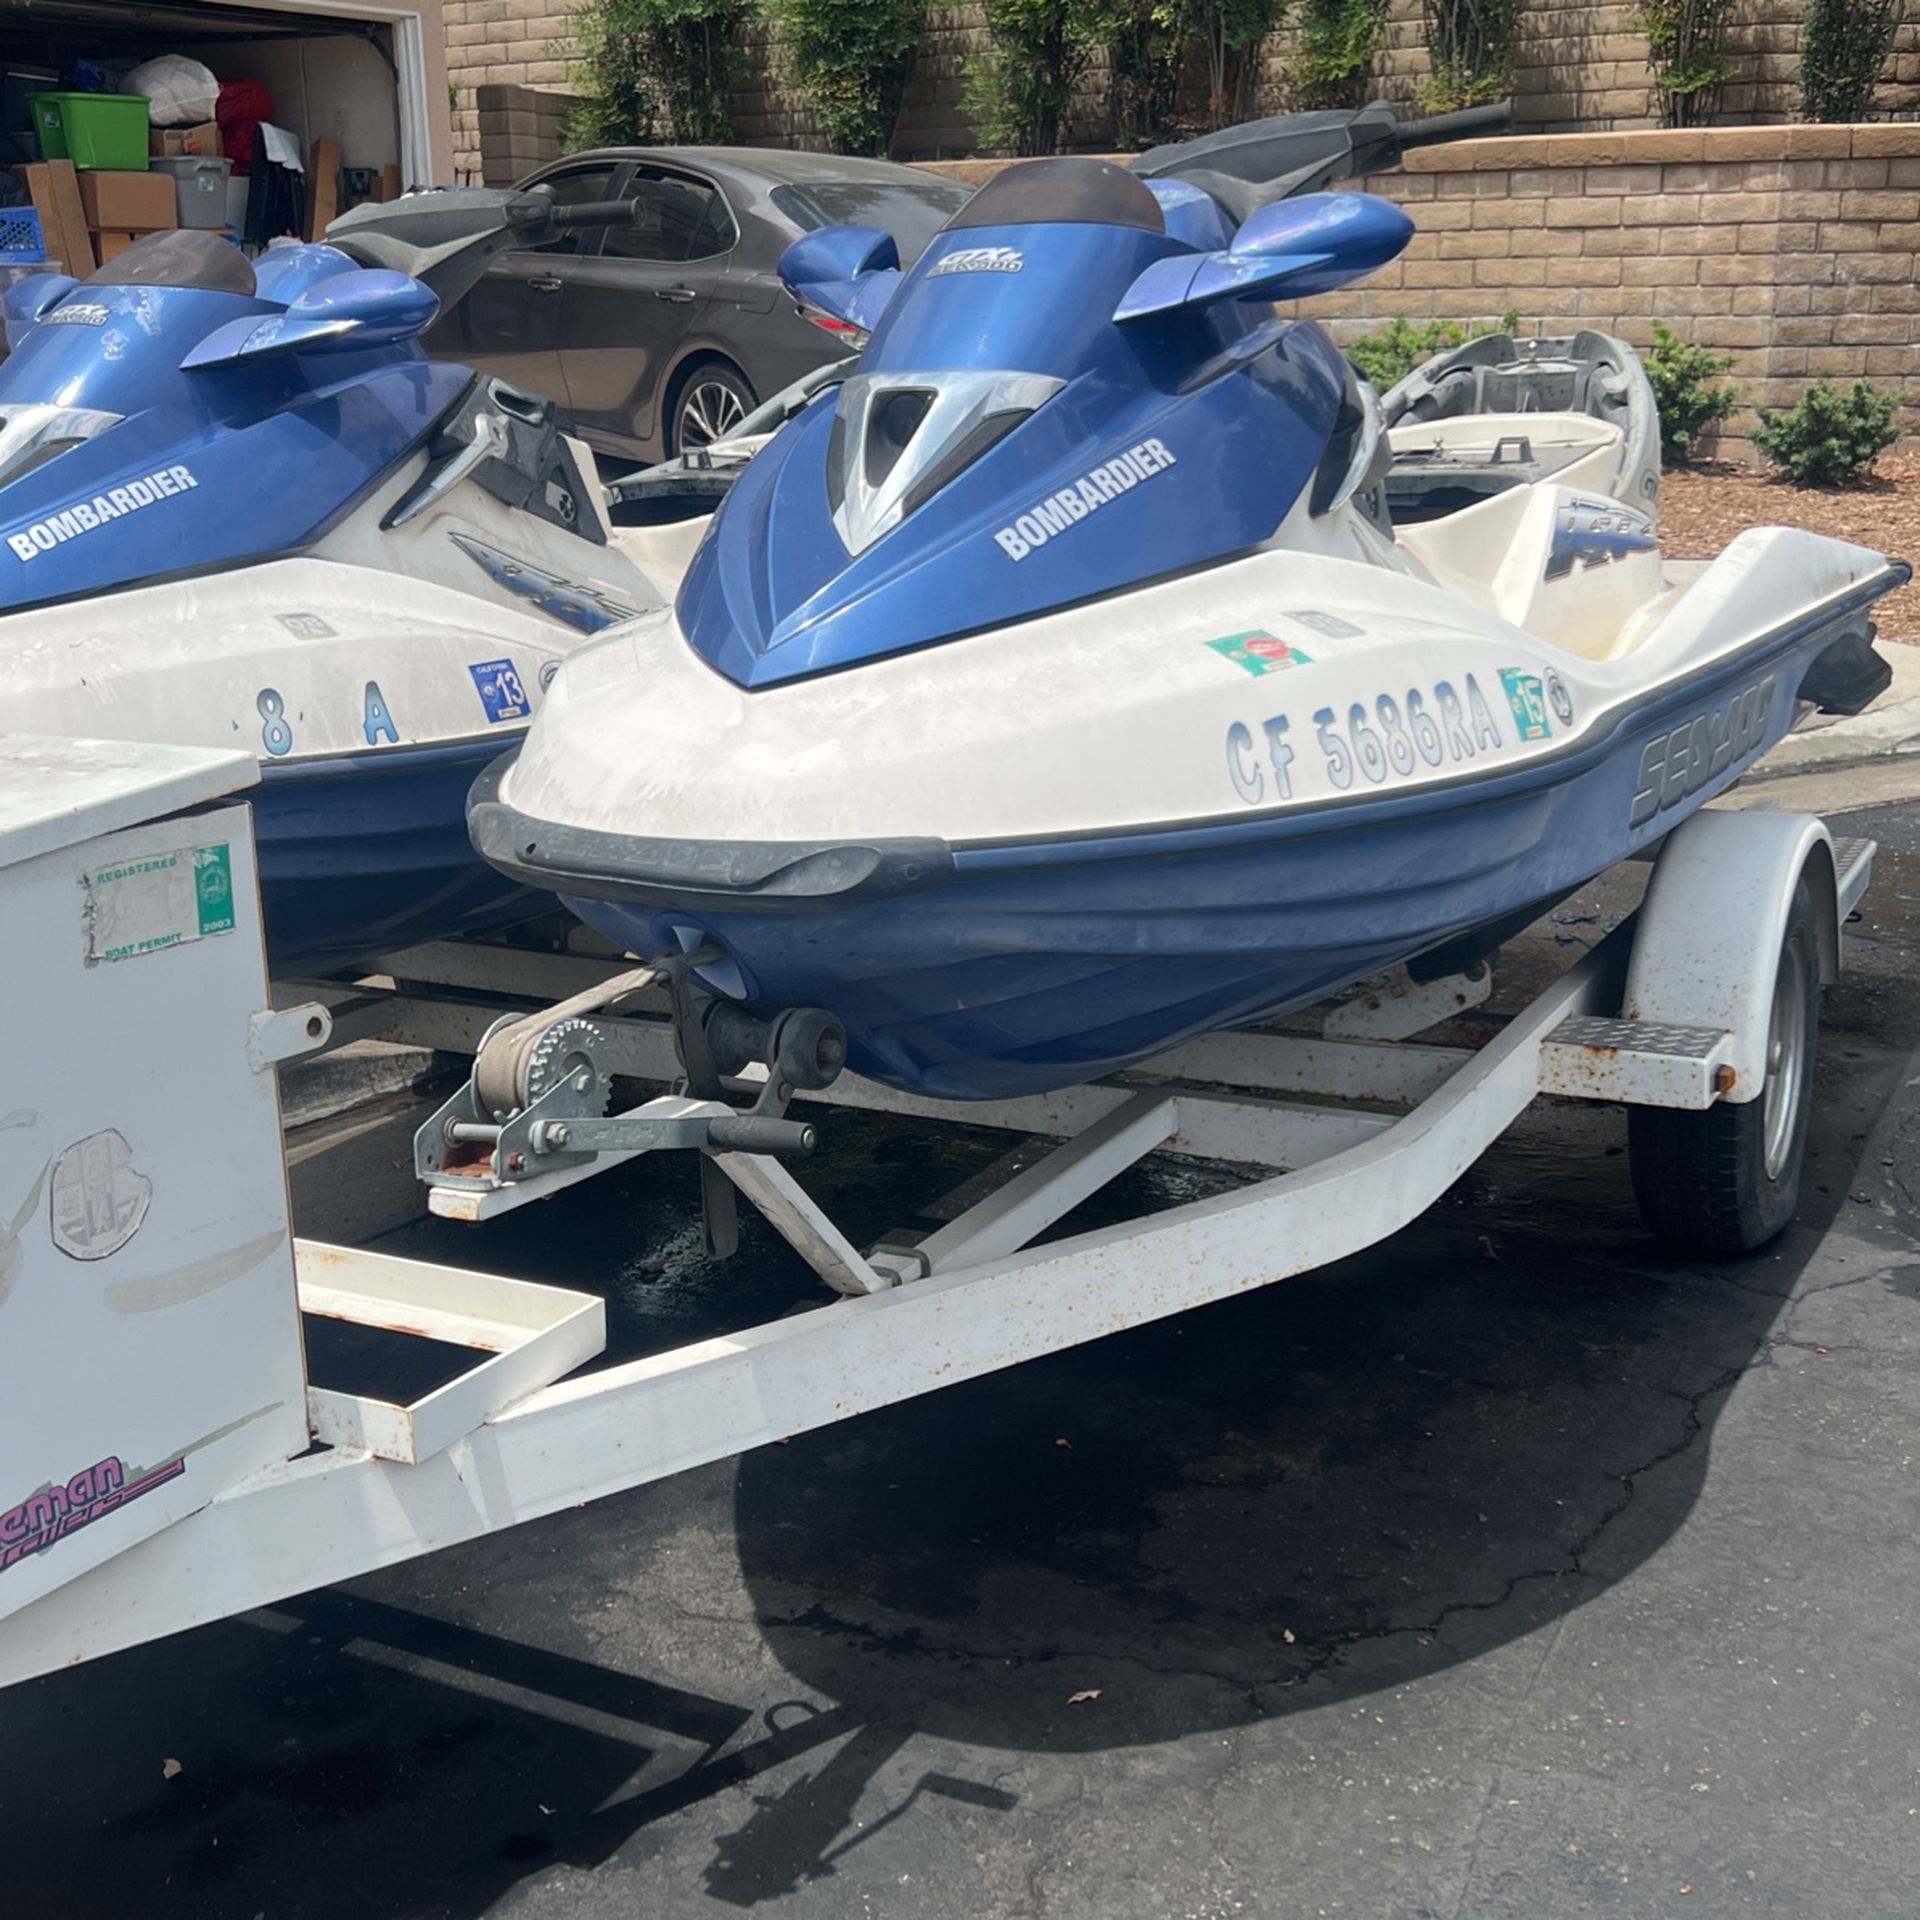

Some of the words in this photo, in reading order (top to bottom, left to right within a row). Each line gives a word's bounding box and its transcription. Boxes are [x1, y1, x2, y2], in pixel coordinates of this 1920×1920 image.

[6, 464, 198, 563] BOMBARDIER
[993, 437, 1177, 563] BOMBARDIER
[496, 671, 525, 706] 13
[256, 687, 293, 756] 8
[363, 680, 399, 746] A
[1226, 713, 1295, 806] CF
[96, 856, 178, 885] REGISTERED
[105, 944, 136, 960] BOAT
[138, 932, 183, 951] PERMIT
[202, 917, 232, 933] 2003
